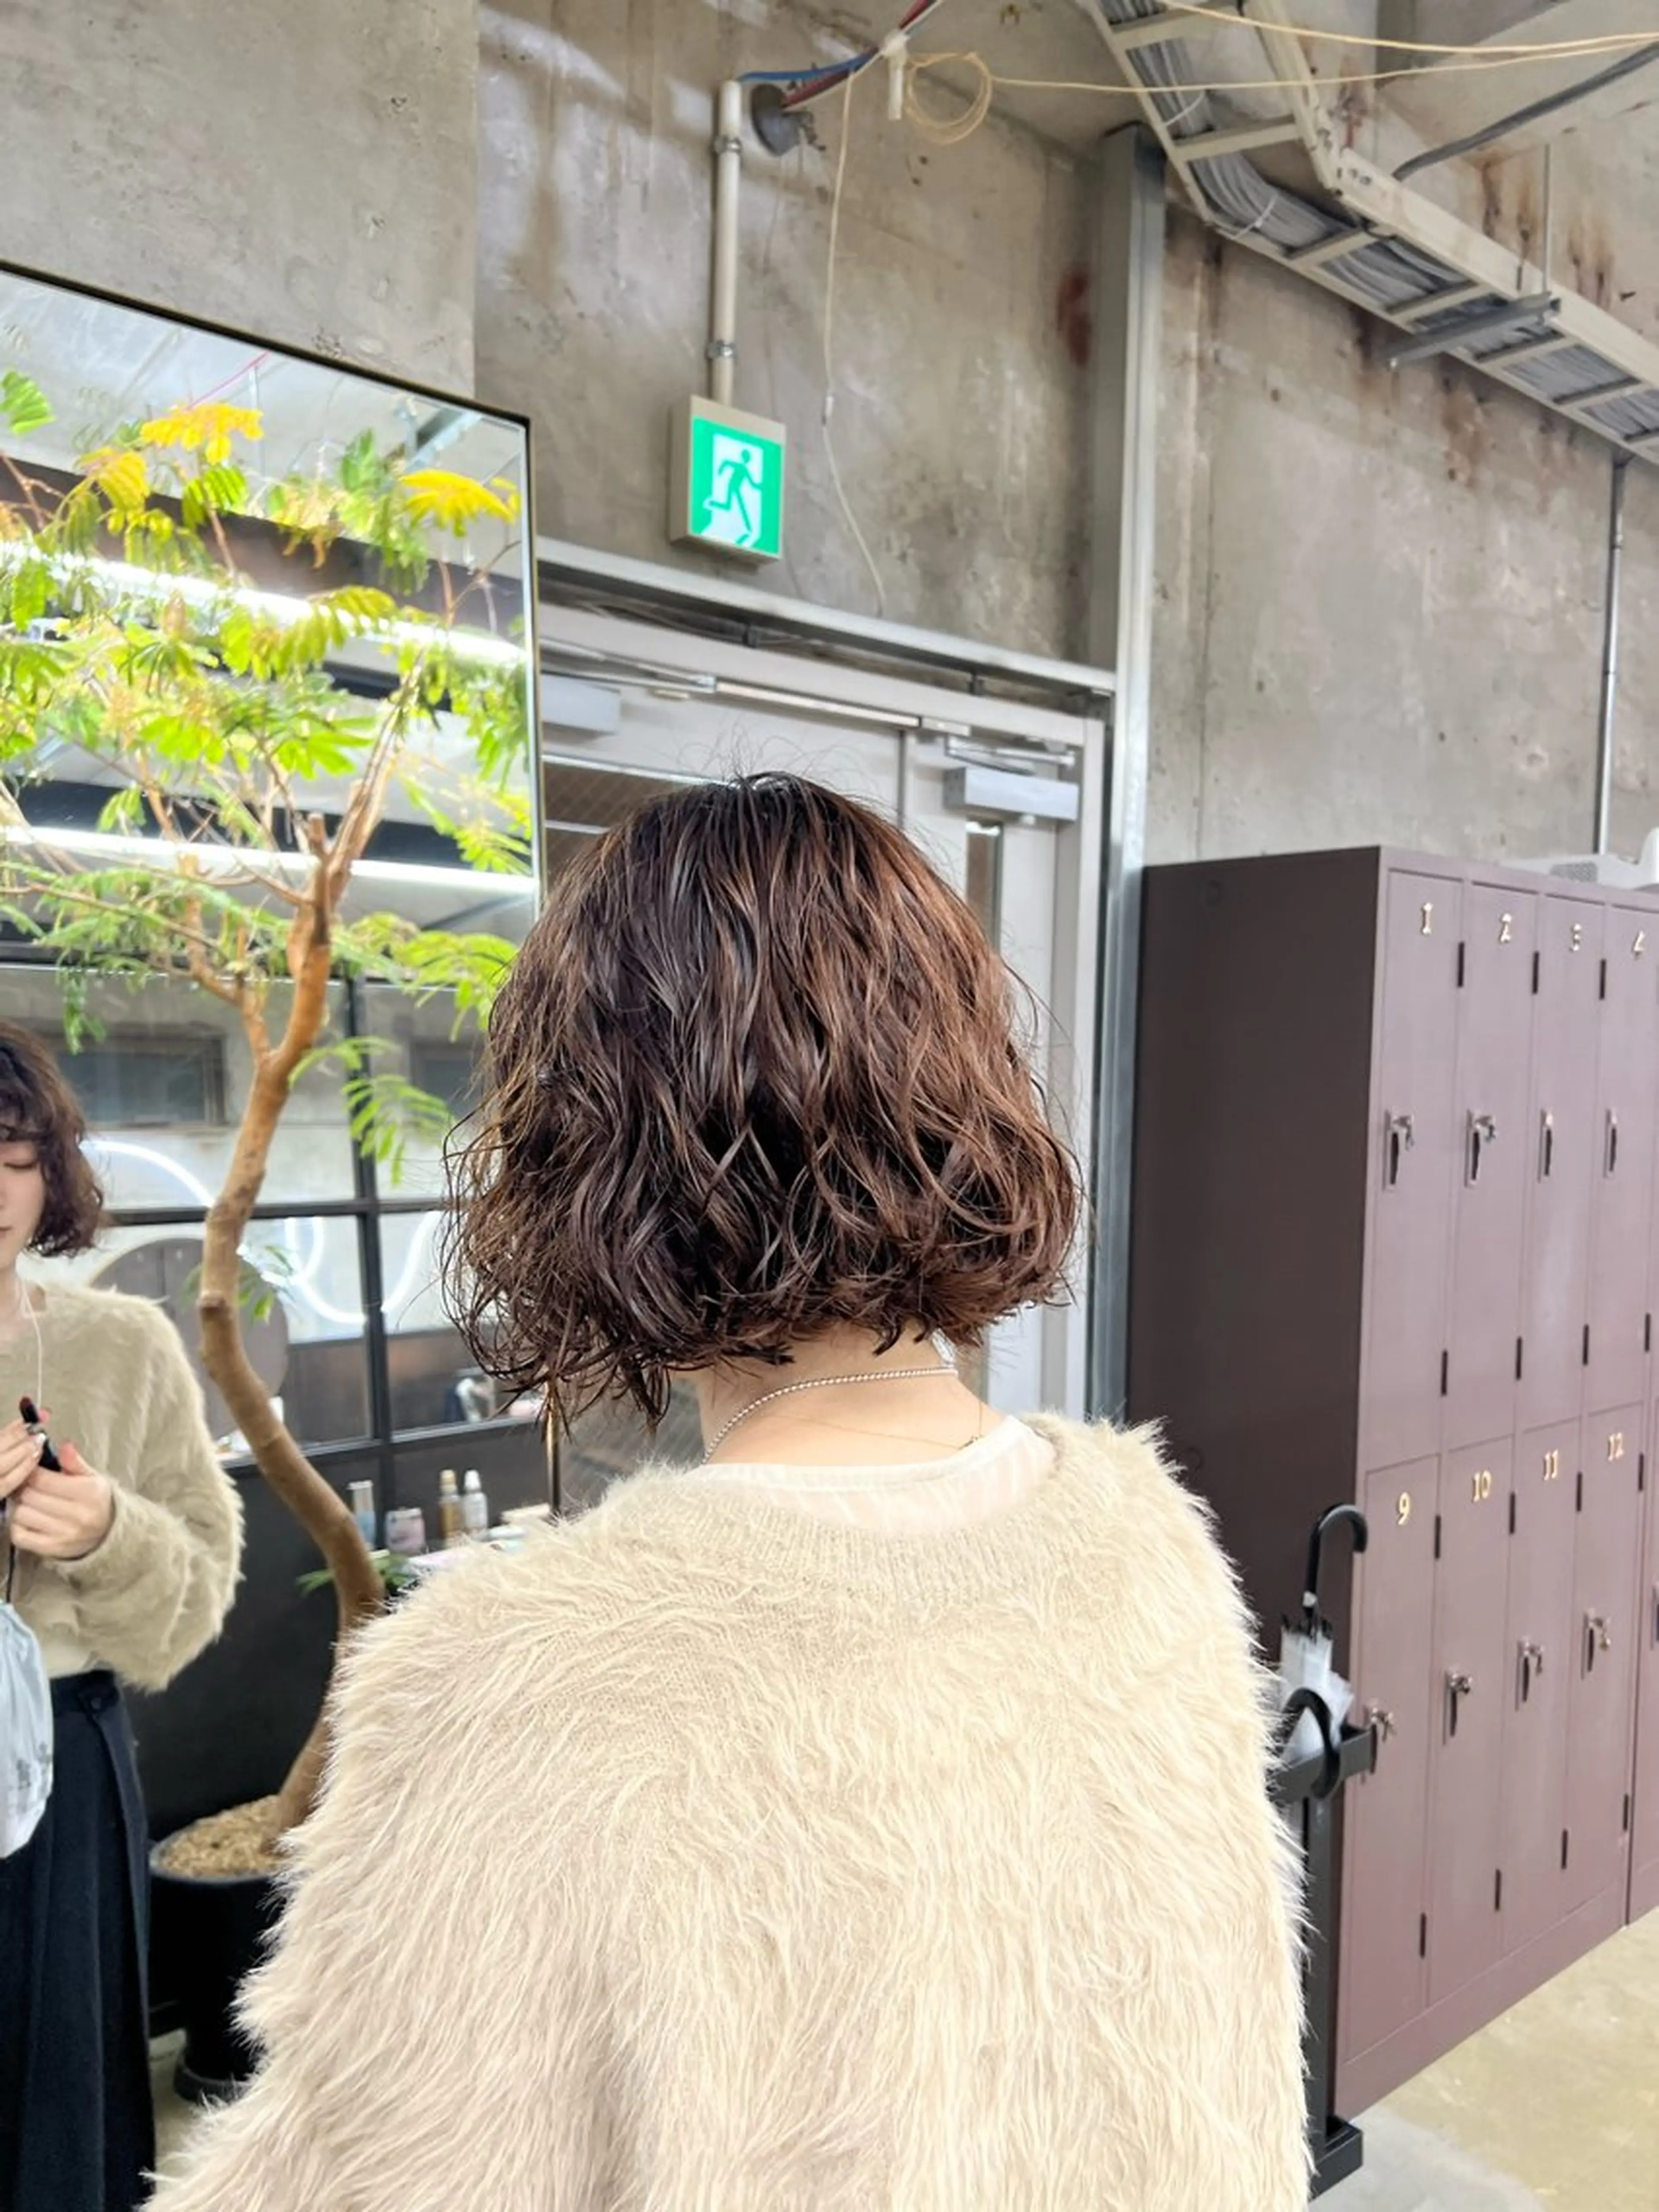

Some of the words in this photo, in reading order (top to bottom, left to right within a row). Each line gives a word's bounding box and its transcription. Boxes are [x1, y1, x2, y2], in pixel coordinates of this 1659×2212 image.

[1422, 902, 1433, 934] 1
[1499, 913, 1512, 942] 2
[1608, 1432, 1624, 1461] 12
[1543, 1449, 1558, 1481] 11
[1472, 1470, 1491, 1502] 10
[1397, 1491, 1411, 1525] 9
